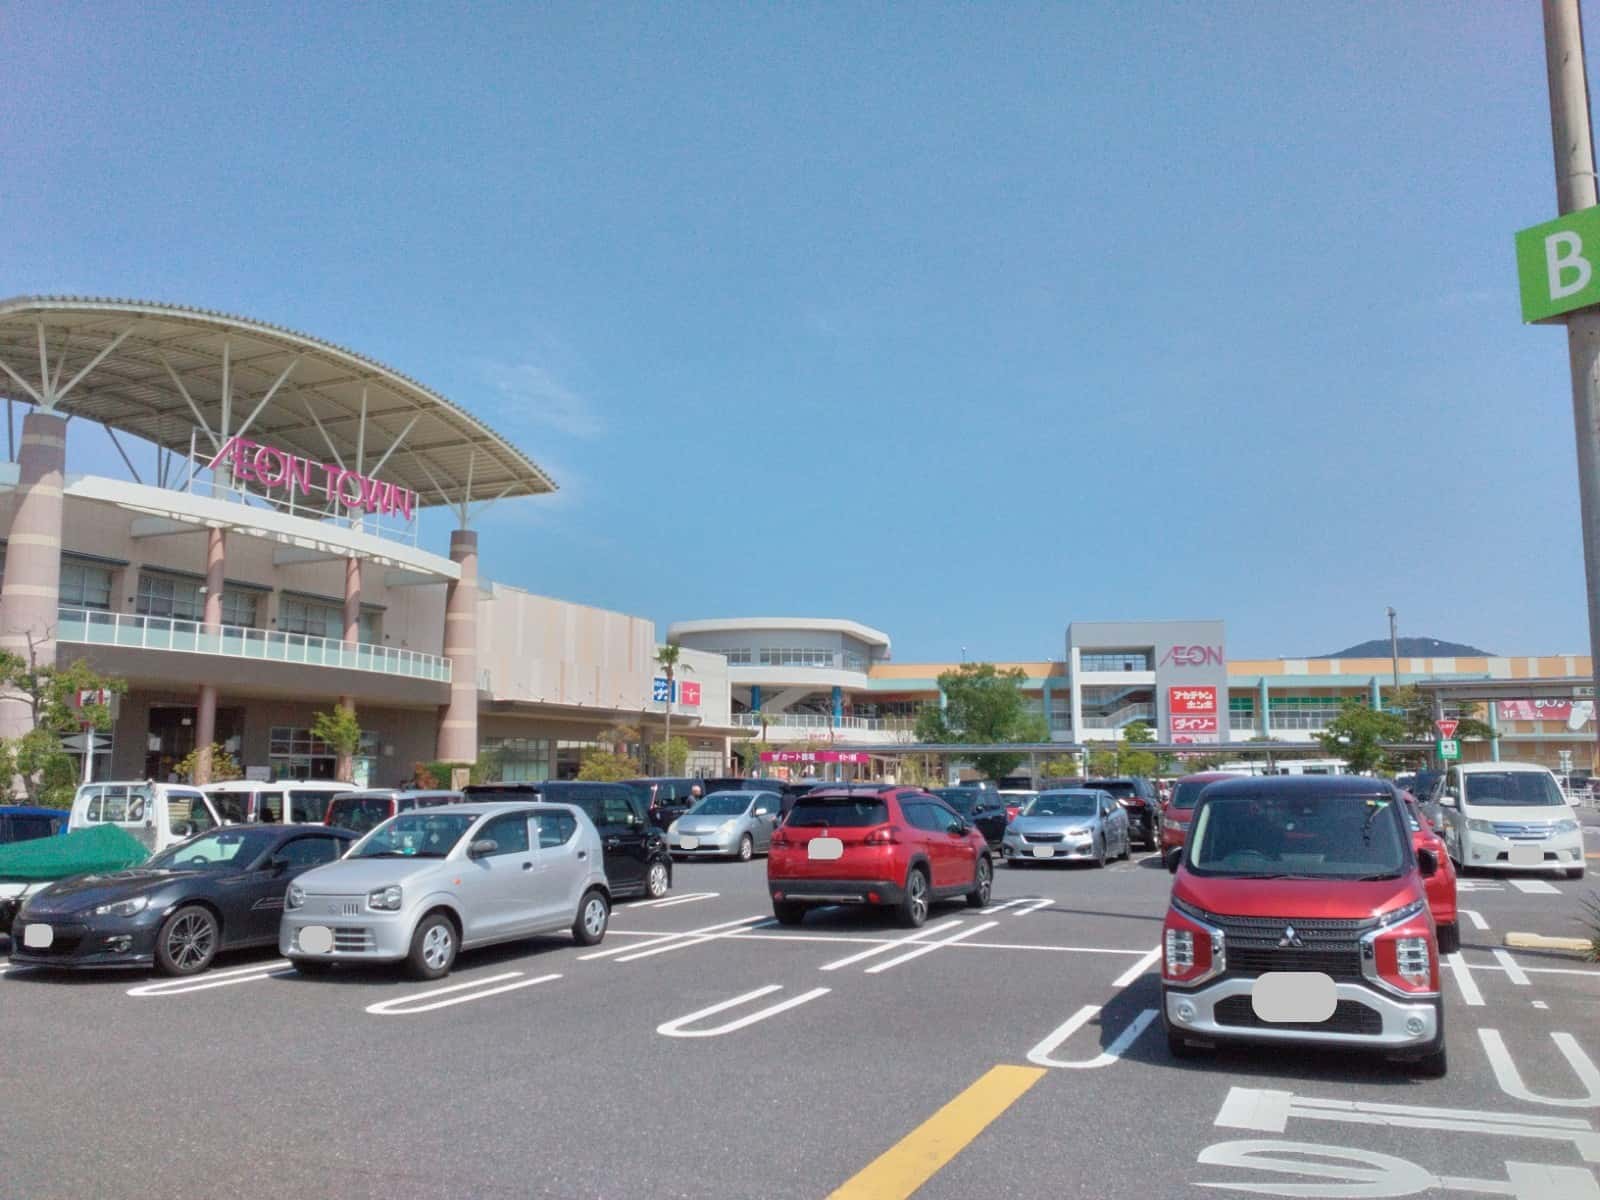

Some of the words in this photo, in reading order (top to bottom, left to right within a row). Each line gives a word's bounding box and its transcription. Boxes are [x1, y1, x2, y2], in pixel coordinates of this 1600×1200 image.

[1545, 230, 1592, 301] B
[208, 436, 311, 496] AEON
[320, 464, 411, 520] TOWN
[1159, 645, 1223, 667] AEON
[1174, 718, 1214, 730] ダイソー
